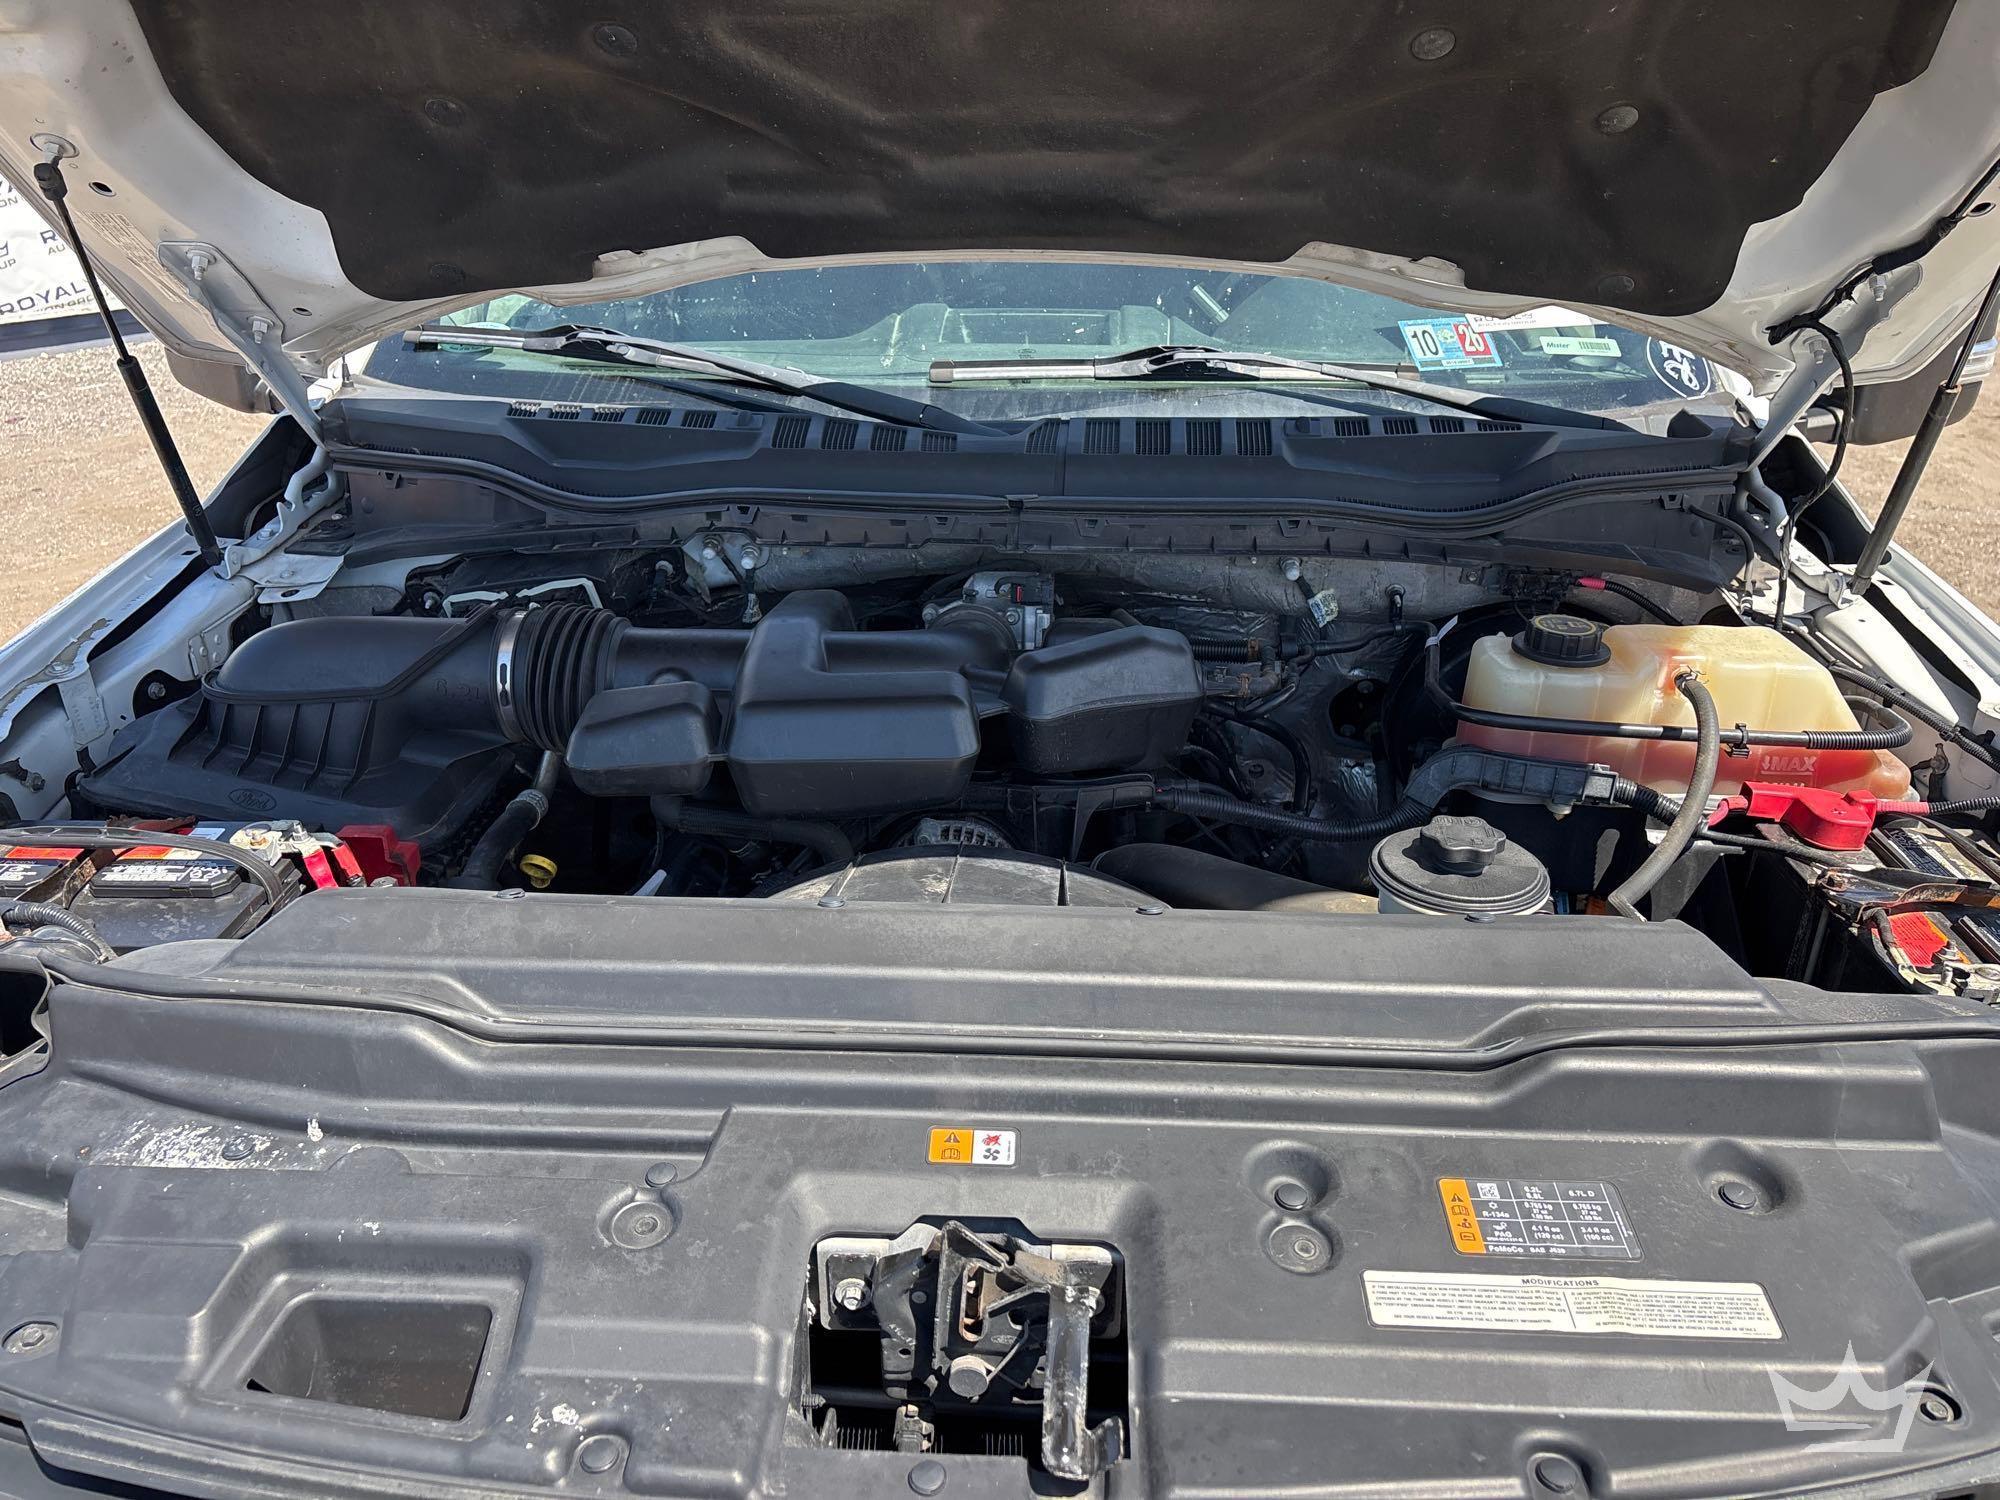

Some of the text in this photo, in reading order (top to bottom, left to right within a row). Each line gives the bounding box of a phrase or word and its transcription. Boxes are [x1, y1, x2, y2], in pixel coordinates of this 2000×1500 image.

[0, 282, 87, 315] ROYAL
[1411, 330, 1440, 356] 10
[1771, 754, 1817, 772] MAX
[1482, 1210, 1510, 1218] R-134a
[1534, 1232, 1551, 1240] (120
[1583, 1233, 1600, 1242] (100
[1521, 1277, 1600, 1287] MODIFICATIONS
